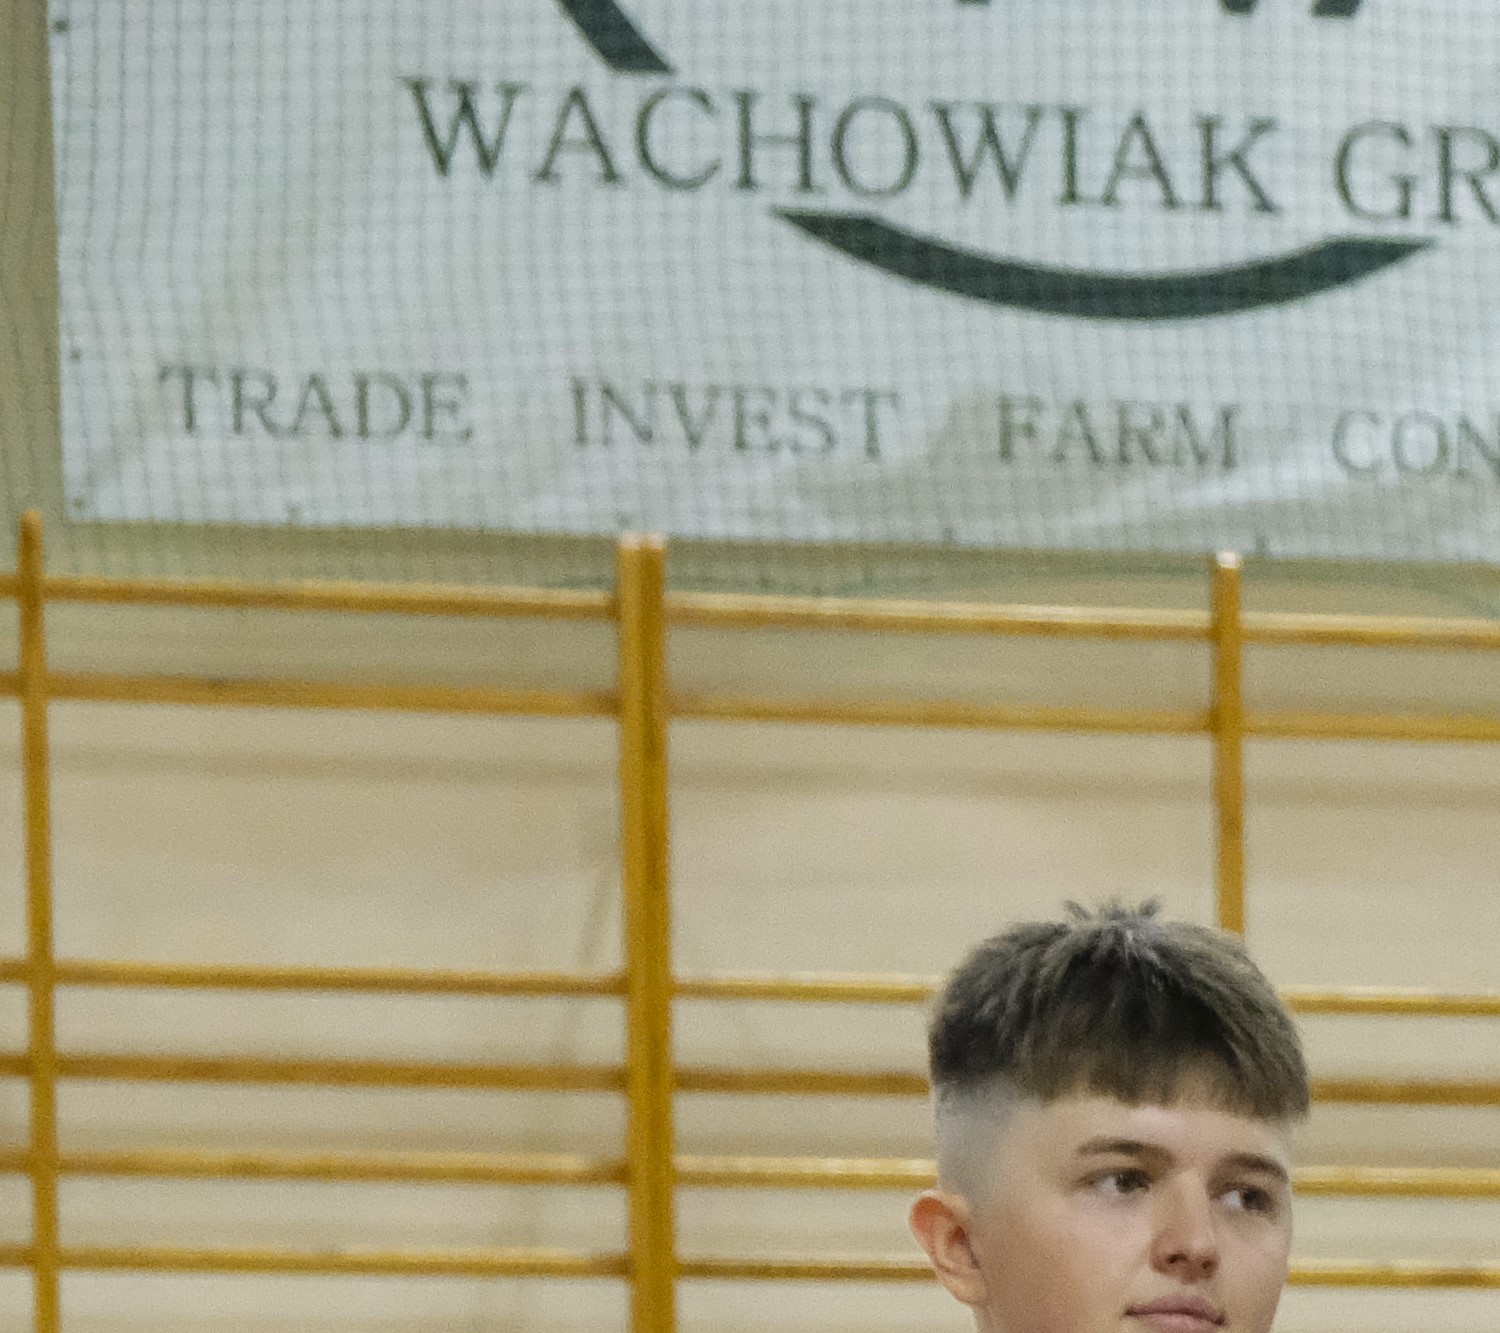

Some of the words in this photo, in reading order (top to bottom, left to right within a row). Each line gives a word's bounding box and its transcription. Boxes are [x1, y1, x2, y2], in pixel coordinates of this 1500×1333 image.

[403, 75, 1284, 214] WACHOWIAK
[156, 362, 474, 446] TRADE
[567, 372, 902, 462] INVEST
[996, 393, 1242, 470] FARM
